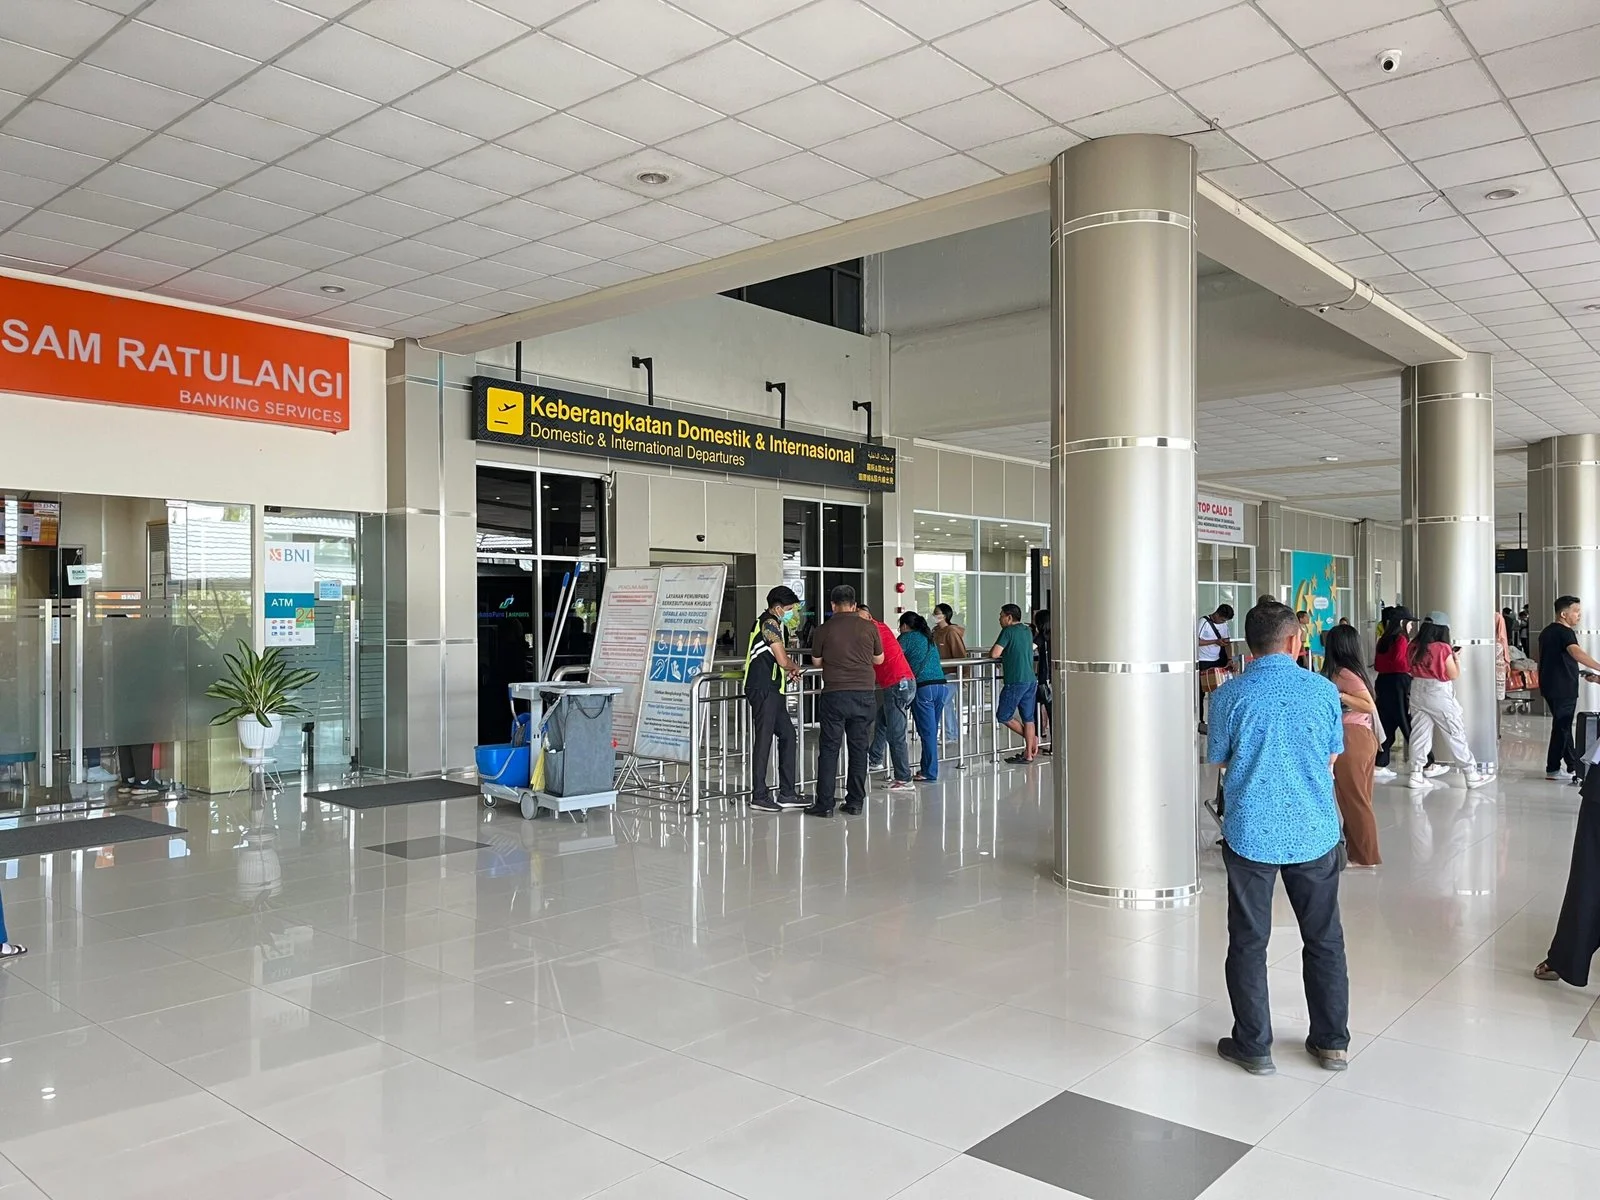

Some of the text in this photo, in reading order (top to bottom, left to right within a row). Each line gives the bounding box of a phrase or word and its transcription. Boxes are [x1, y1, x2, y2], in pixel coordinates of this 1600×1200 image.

[1, 319, 343, 400] SAM RATULANGI
[180, 390, 342, 424] BANKING SERVICES
[530, 394, 855, 464] Keberangkatan Domestik & Internasional
[530, 422, 745, 466] Domestic & International Departures
[1197, 502, 1210, 513] TOP
[1212, 504, 1228, 516] CALO
[284, 548, 310, 562] BNI
[271, 598, 293, 607] ATM
[296, 607, 316, 623] 24
